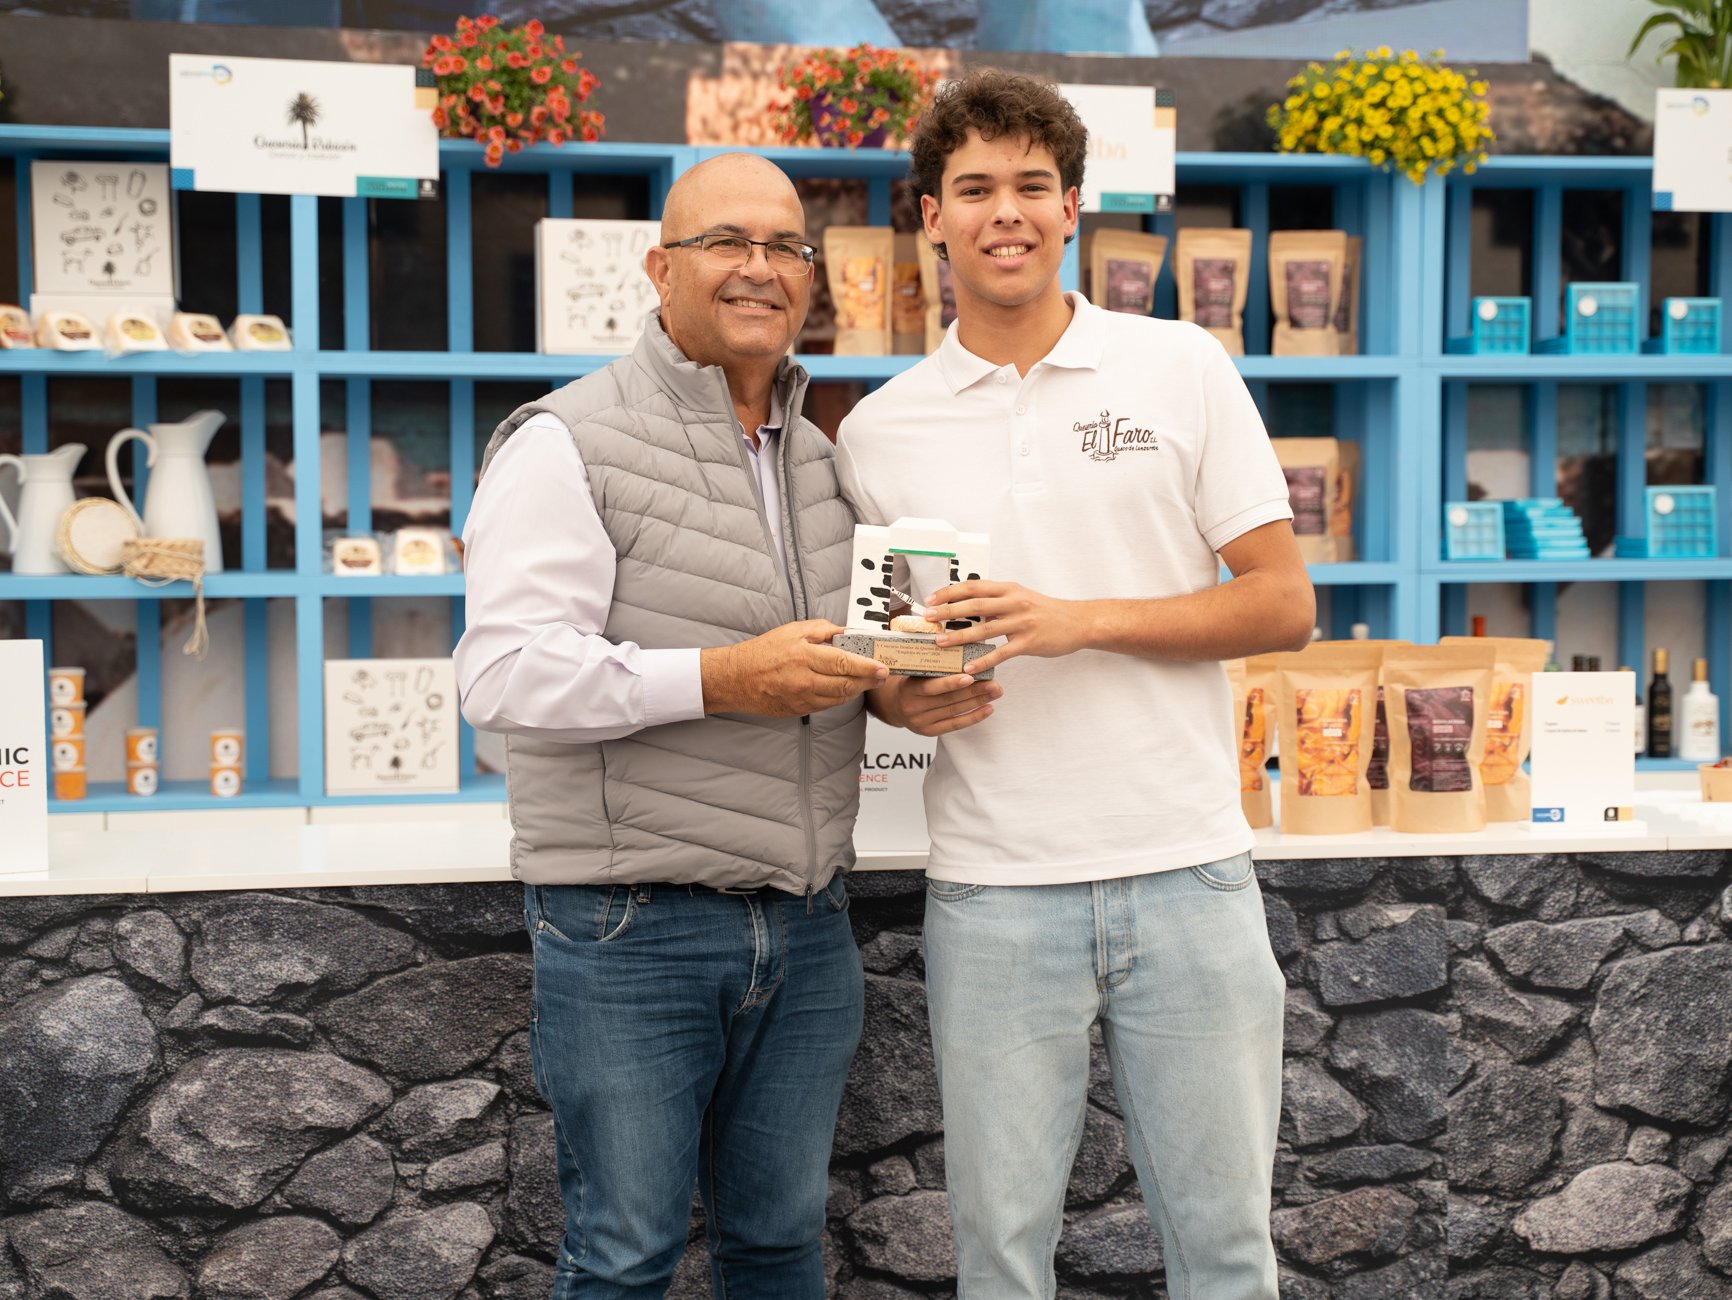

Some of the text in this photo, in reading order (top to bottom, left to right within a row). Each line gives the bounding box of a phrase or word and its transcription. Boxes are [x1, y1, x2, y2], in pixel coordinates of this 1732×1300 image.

[1082, 430, 1097, 452] El
[1112, 418, 1154, 447] Faro
[0, 747, 29, 765] IC
[864, 753, 931, 769] LCANI
[0, 770, 30, 788] CE
